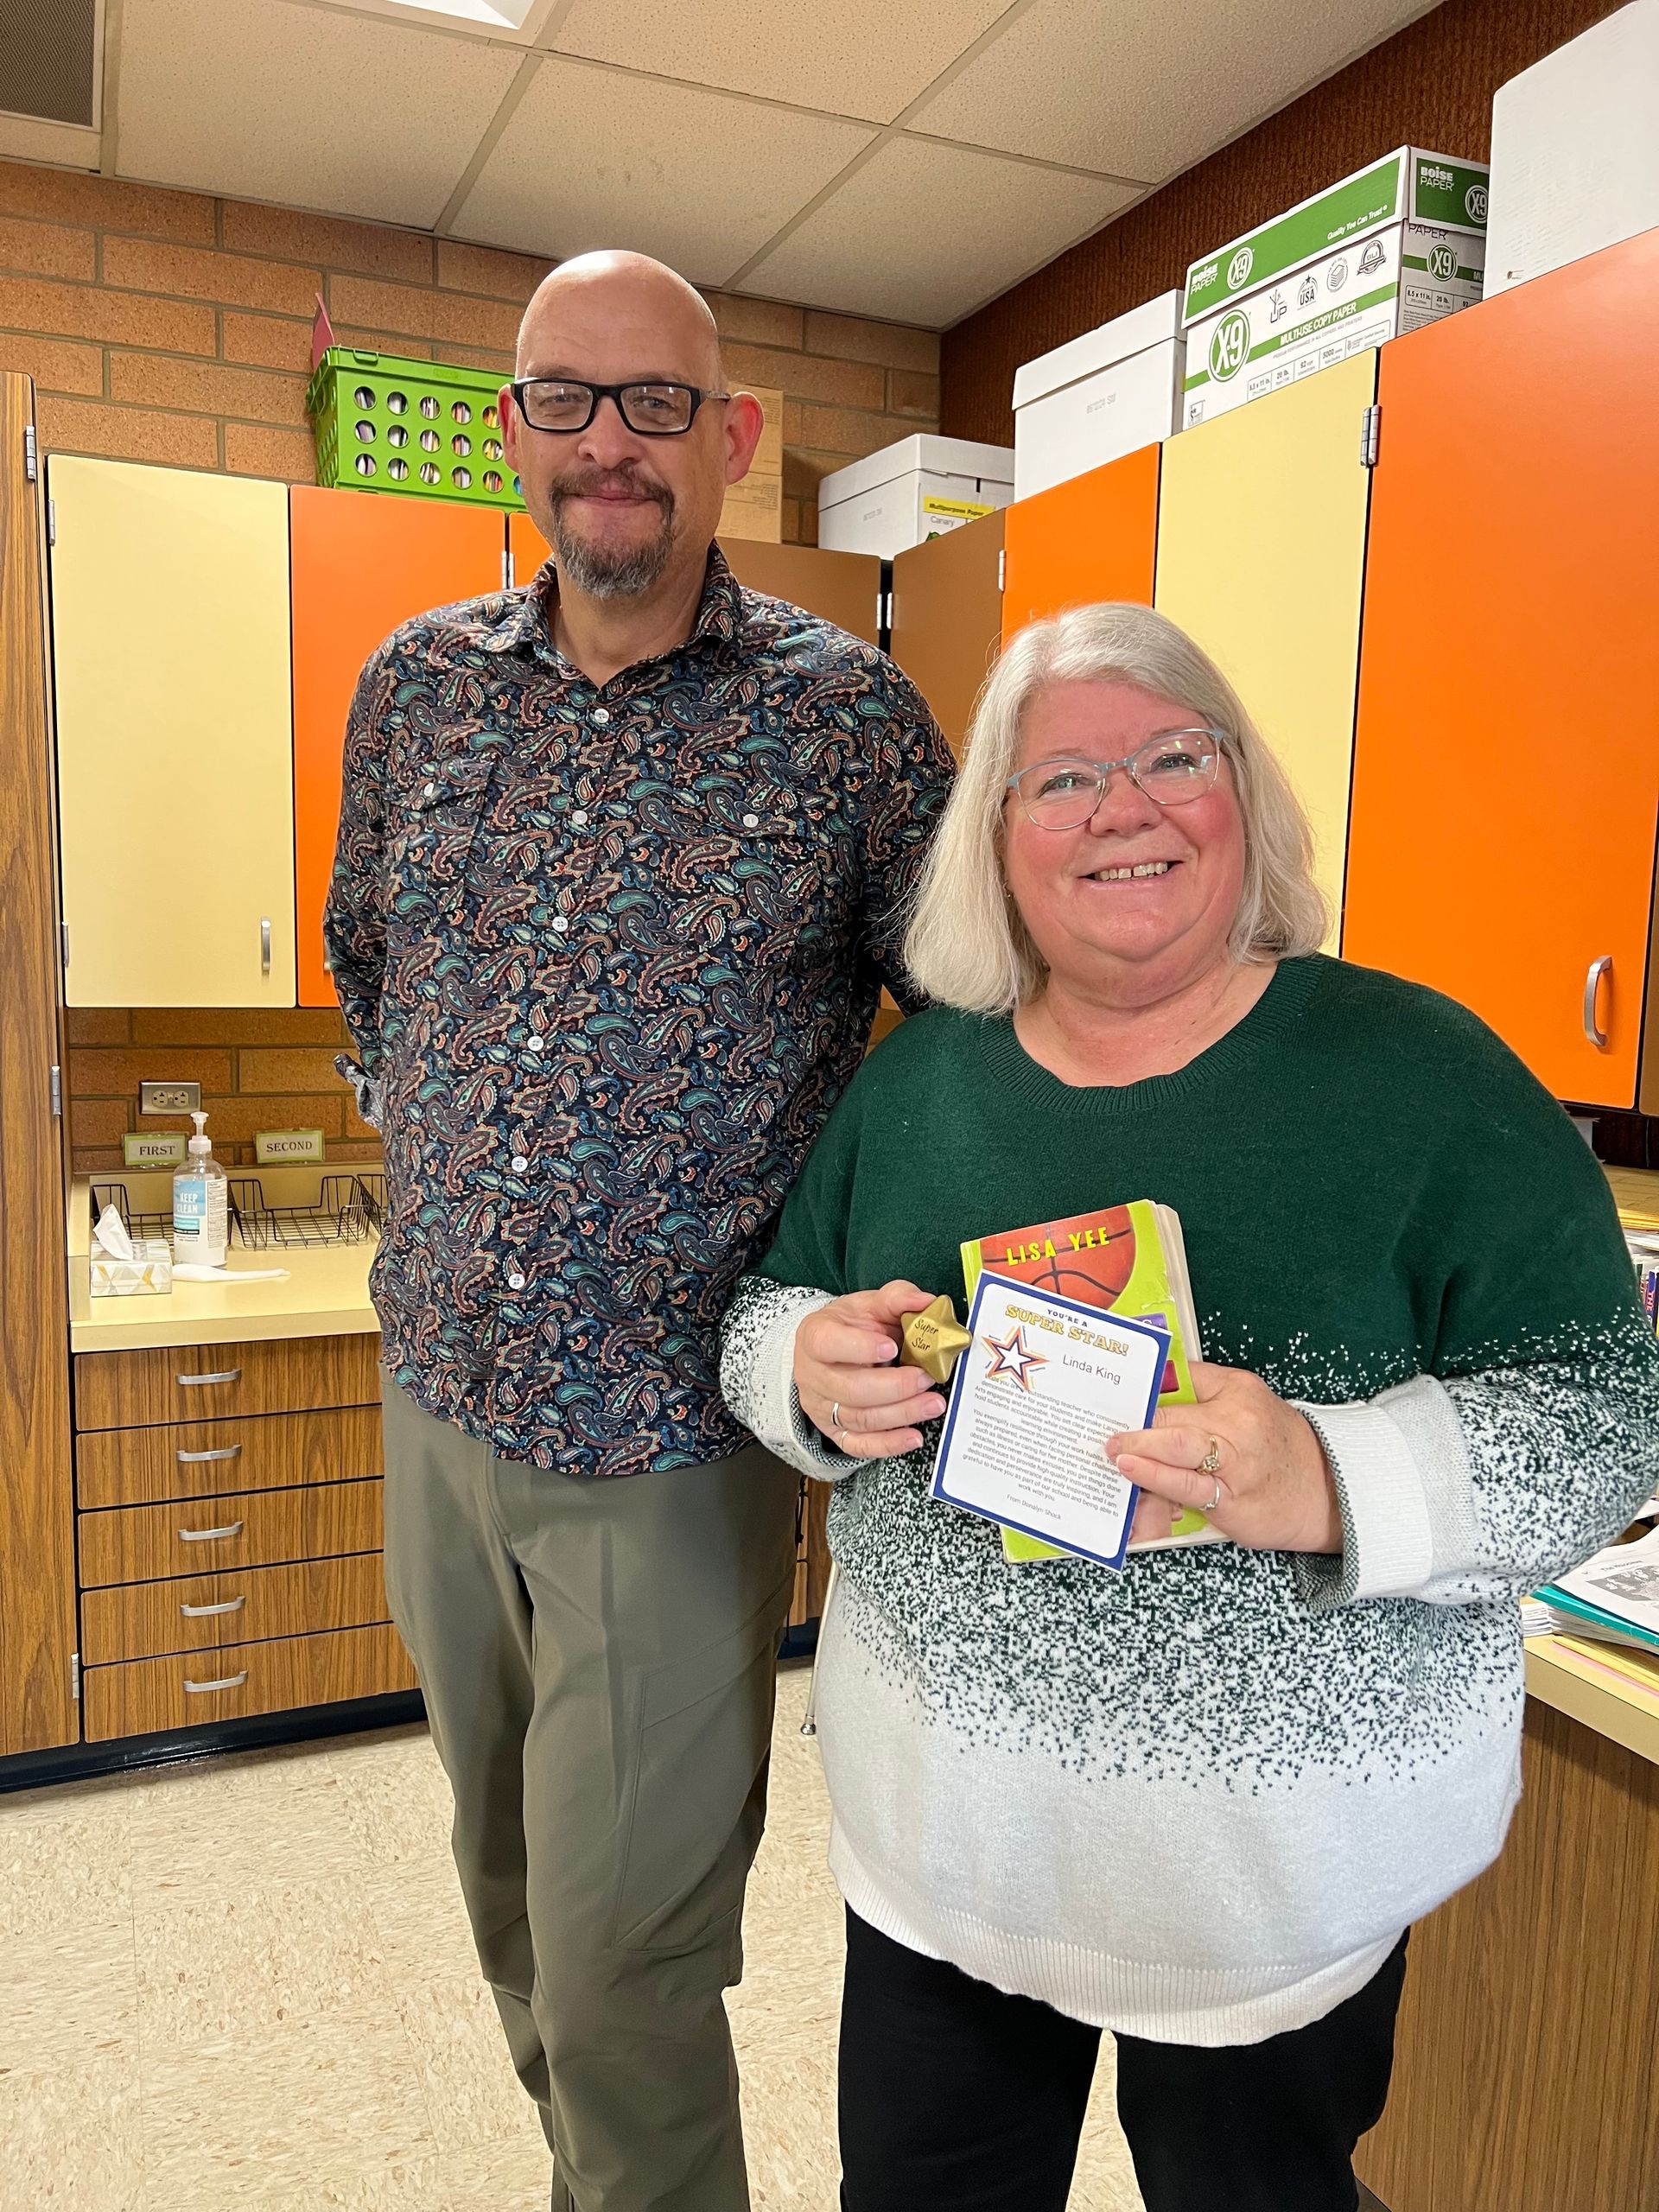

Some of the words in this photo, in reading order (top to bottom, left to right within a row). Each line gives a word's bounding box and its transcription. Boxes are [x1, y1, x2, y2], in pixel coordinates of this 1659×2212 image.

[1420, 176, 1453, 191] PAPER
[1471, 193, 1487, 216] X9
[1327, 226, 1345, 240] Quality
[1346, 221, 1357, 231] You
[1357, 215, 1368, 226] Can
[1368, 207, 1382, 219] Trust
[1408, 224, 1447, 240] PAPER
[1230, 253, 1249, 283] X9
[1433, 249, 1452, 276] X9
[1190, 272, 1218, 295] PAPER
[1300, 289, 1314, 305] USA
[1280, 321, 1313, 345] MULTI-USE
[1313, 312, 1333, 329] COPY
[1333, 302, 1357, 321] PAPER
[1215, 318, 1243, 374] X9
[931, 516, 955, 527] Canary
[139, 1146, 175, 1156] FIRST
[266, 1141, 313, 1152] SECOND
[176, 1204, 199, 1214] CLEAN
[180, 1193, 199, 1204] KEEP
[1006, 1239, 1057, 1266] LISA
[1068, 1227, 1110, 1252] YEE
[914, 1319, 939, 1338] Super
[1047, 1309, 1079, 1324] YOU'RE
[912, 1337, 931, 1351] Star
[1005, 1304, 1064, 1335] SUPER
[1068, 1325, 1129, 1357] STAR!
[1062, 1354, 1093, 1374] Linda
[1096, 1366, 1122, 1385] King
[975, 1393, 986, 1401] hold
[987, 1398, 1009, 1410] students
[1044, 1420, 1058, 1428] while
[1059, 1425, 1081, 1438] creating
[1049, 1405, 1073, 1417] students
[1086, 1419, 1102, 1428] make
[1103, 1424, 1118, 1434] Lang
[1051, 1413, 1061, 1421] You
[974, 1408, 983, 1417] You
[1036, 1433, 1057, 1444] through
[1071, 1446, 1084, 1455] work
[968, 1447, 995, 1461] dedication
[1006, 1462, 1042, 1479] perseverance
[976, 1426, 988, 1435] such
[1021, 1444, 1038, 1454] caring
[1080, 1465, 1101, 1477] Despite
[1102, 1474, 1118, 1484] these
[1033, 1440, 1047, 1448] when
[1049, 1445, 1065, 1457] facing
[1066, 1453, 1091, 1465] personal
[963, 1454, 983, 1464] grateful
[990, 1463, 1003, 1472] have
[1052, 1488, 1070, 1498] school
[1082, 1499, 1098, 1510] being
[983, 1445, 1009, 1459] continues
[1016, 1458, 1036, 1469] provide
[1103, 1490, 1115, 1498] Your
[1007, 1447, 1022, 1455] never
[1023, 1452, 1041, 1463] makes
[1089, 1477, 1105, 1487] things
[1107, 1484, 1121, 1493] done
